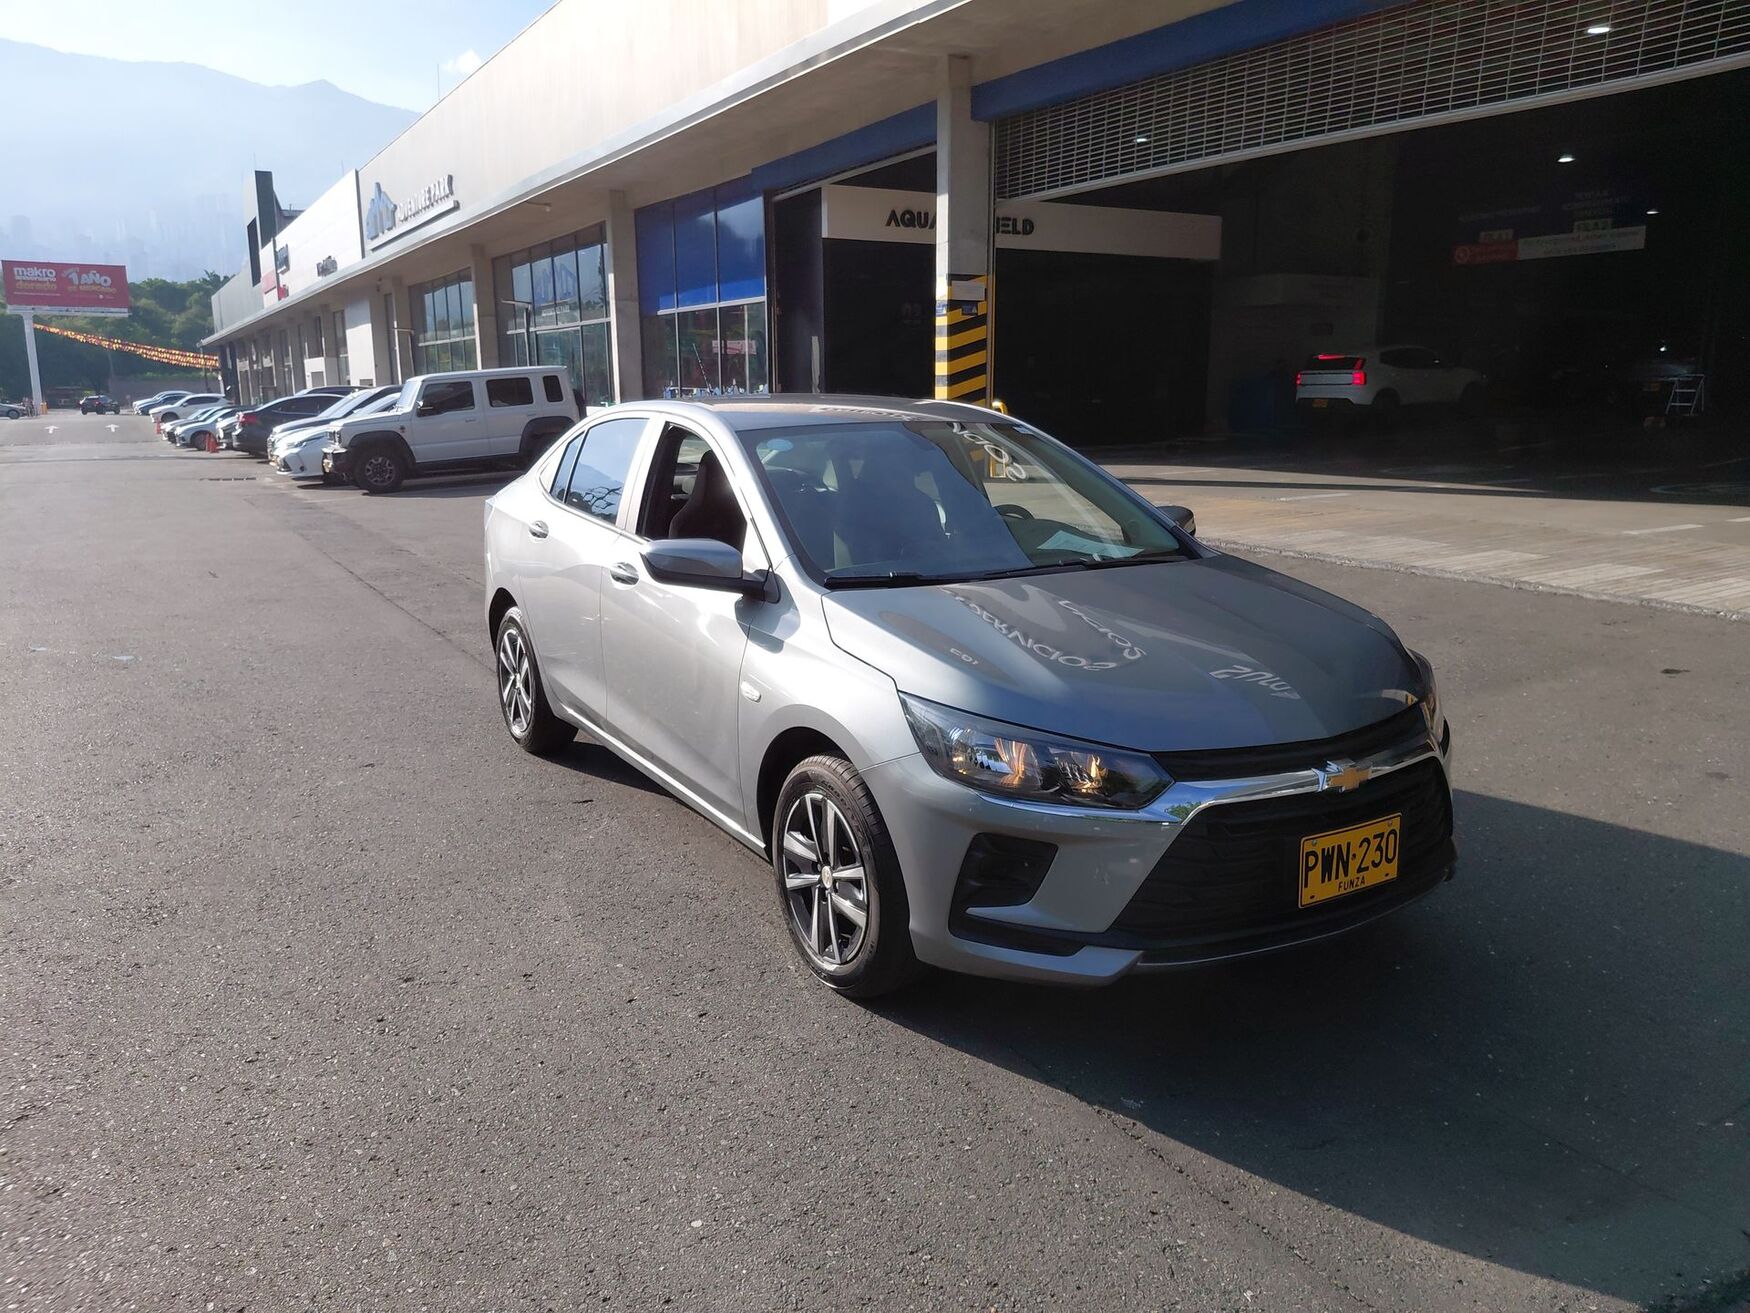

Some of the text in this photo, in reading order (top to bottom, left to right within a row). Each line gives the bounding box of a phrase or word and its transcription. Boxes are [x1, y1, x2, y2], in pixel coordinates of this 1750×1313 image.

[996, 216, 1035, 235] IELD
[13, 266, 56, 278] makro
[1338, 875, 1365, 892] FUNZA
